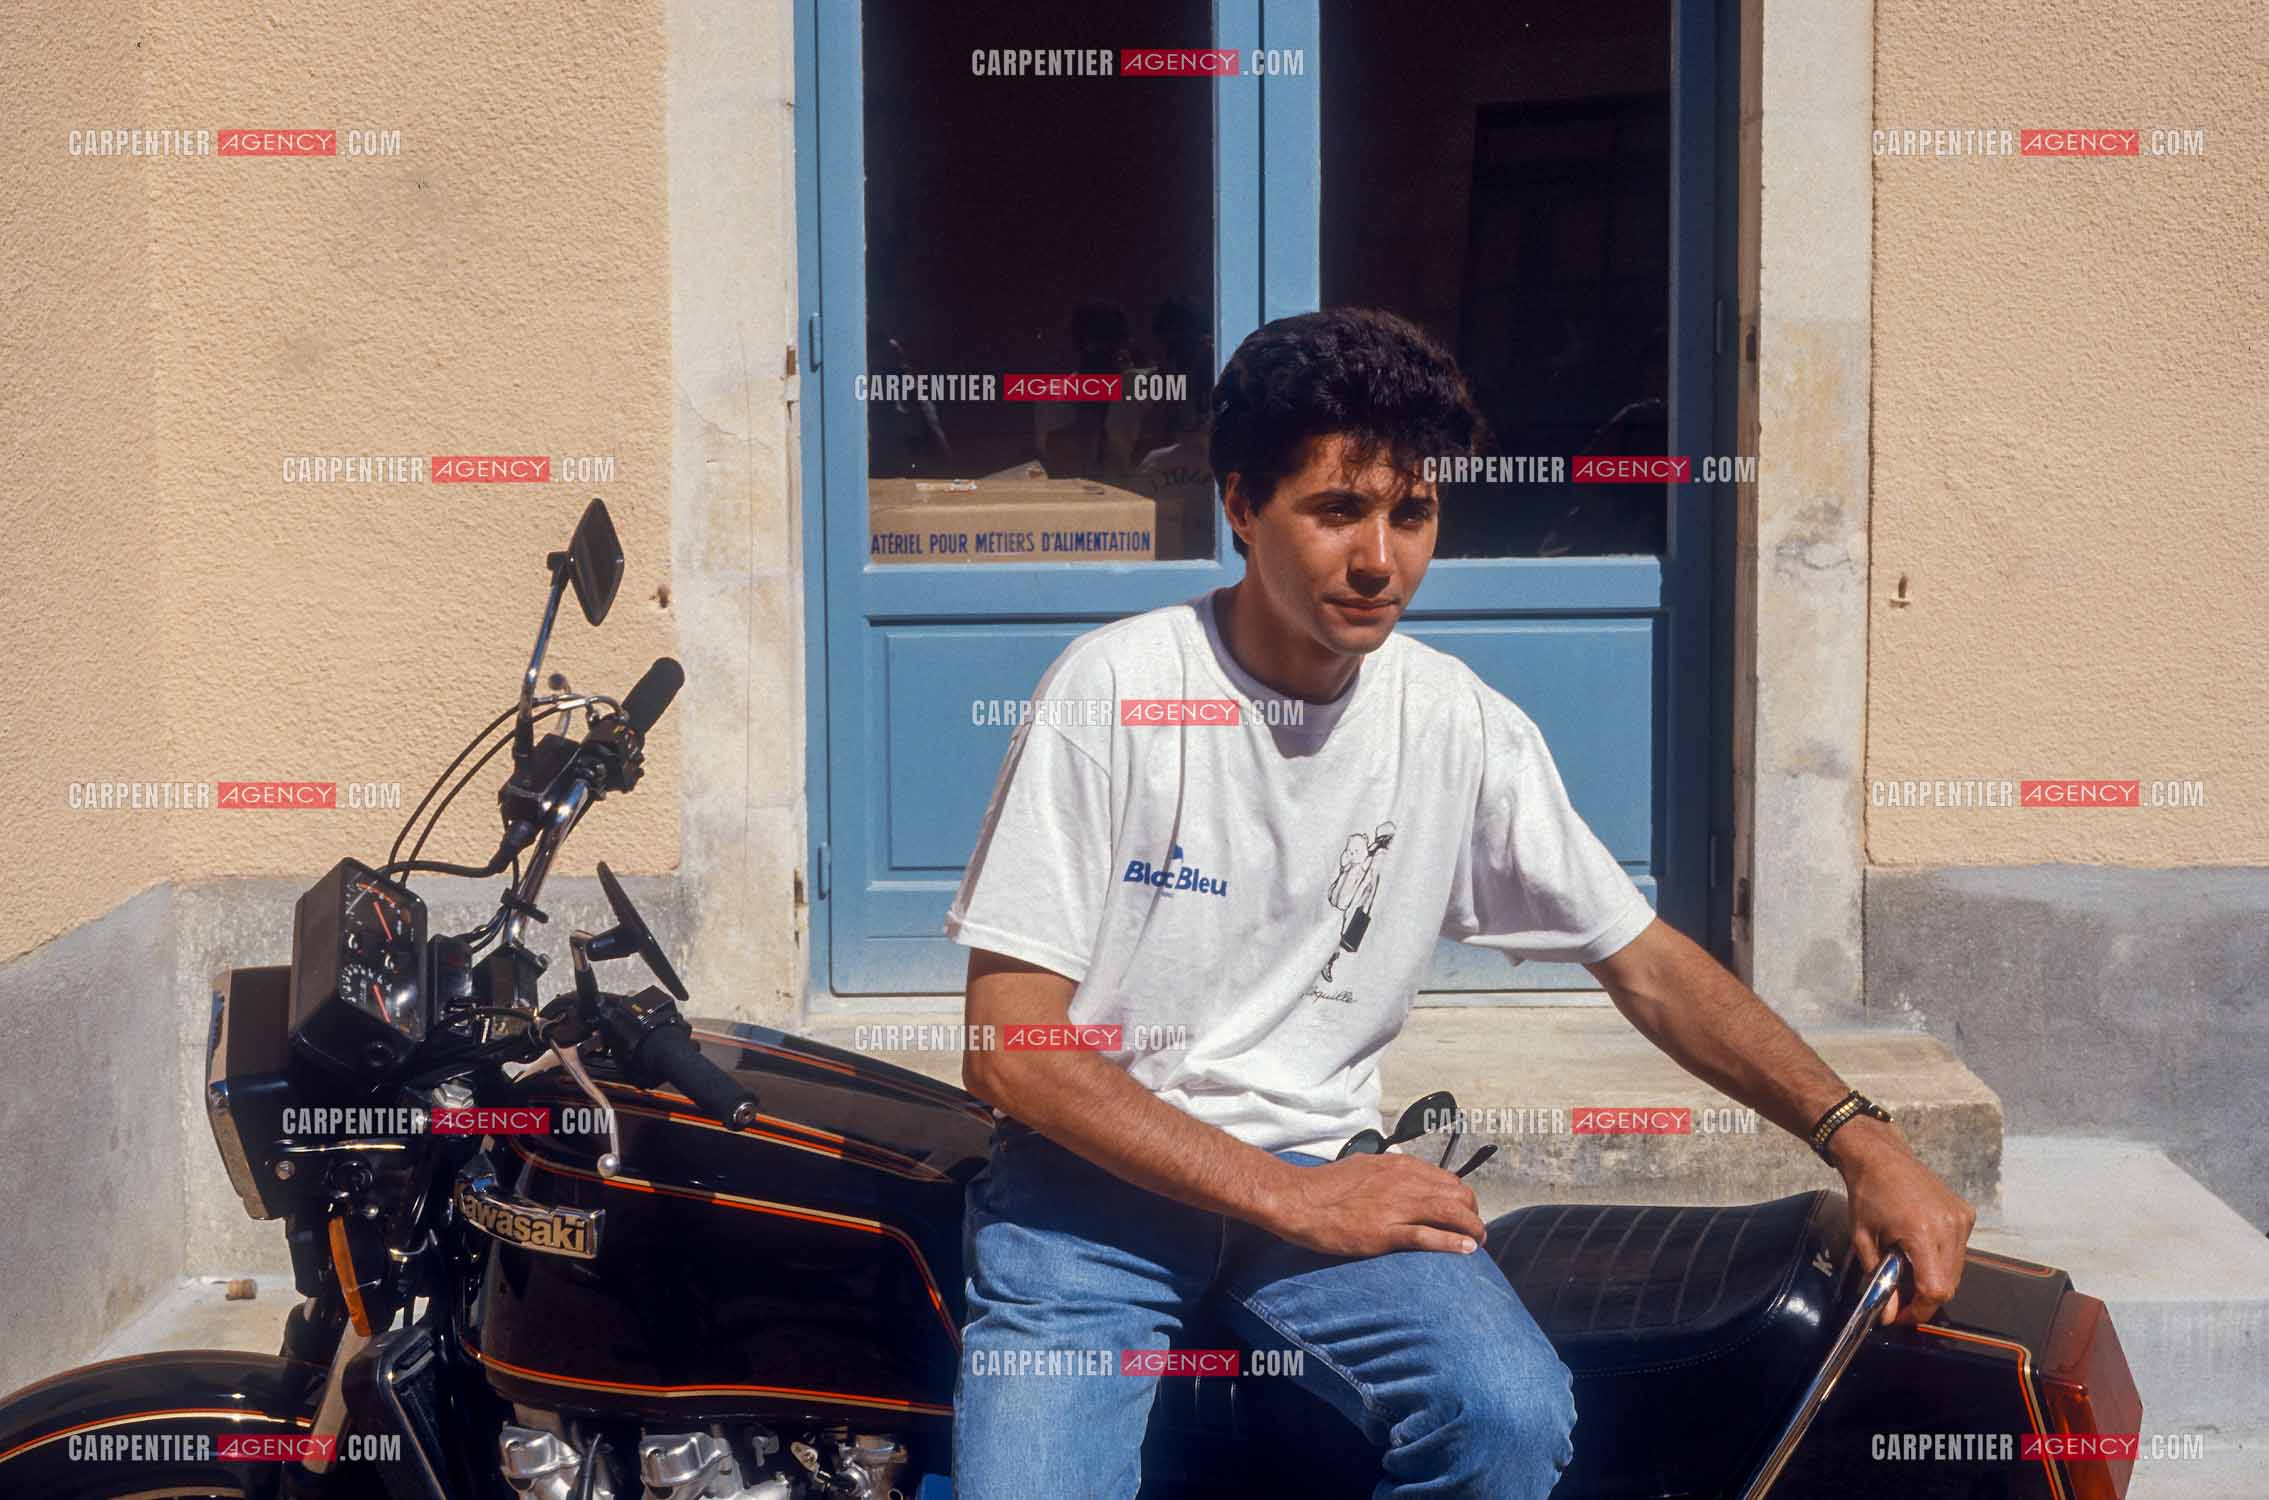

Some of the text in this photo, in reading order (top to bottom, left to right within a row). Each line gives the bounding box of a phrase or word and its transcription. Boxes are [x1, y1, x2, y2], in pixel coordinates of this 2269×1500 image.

[871, 530, 1150, 555] ATÉRIEL POUR MÉTIERS D'ALIMENTATION
[462, 1193, 585, 1252] awasaki
